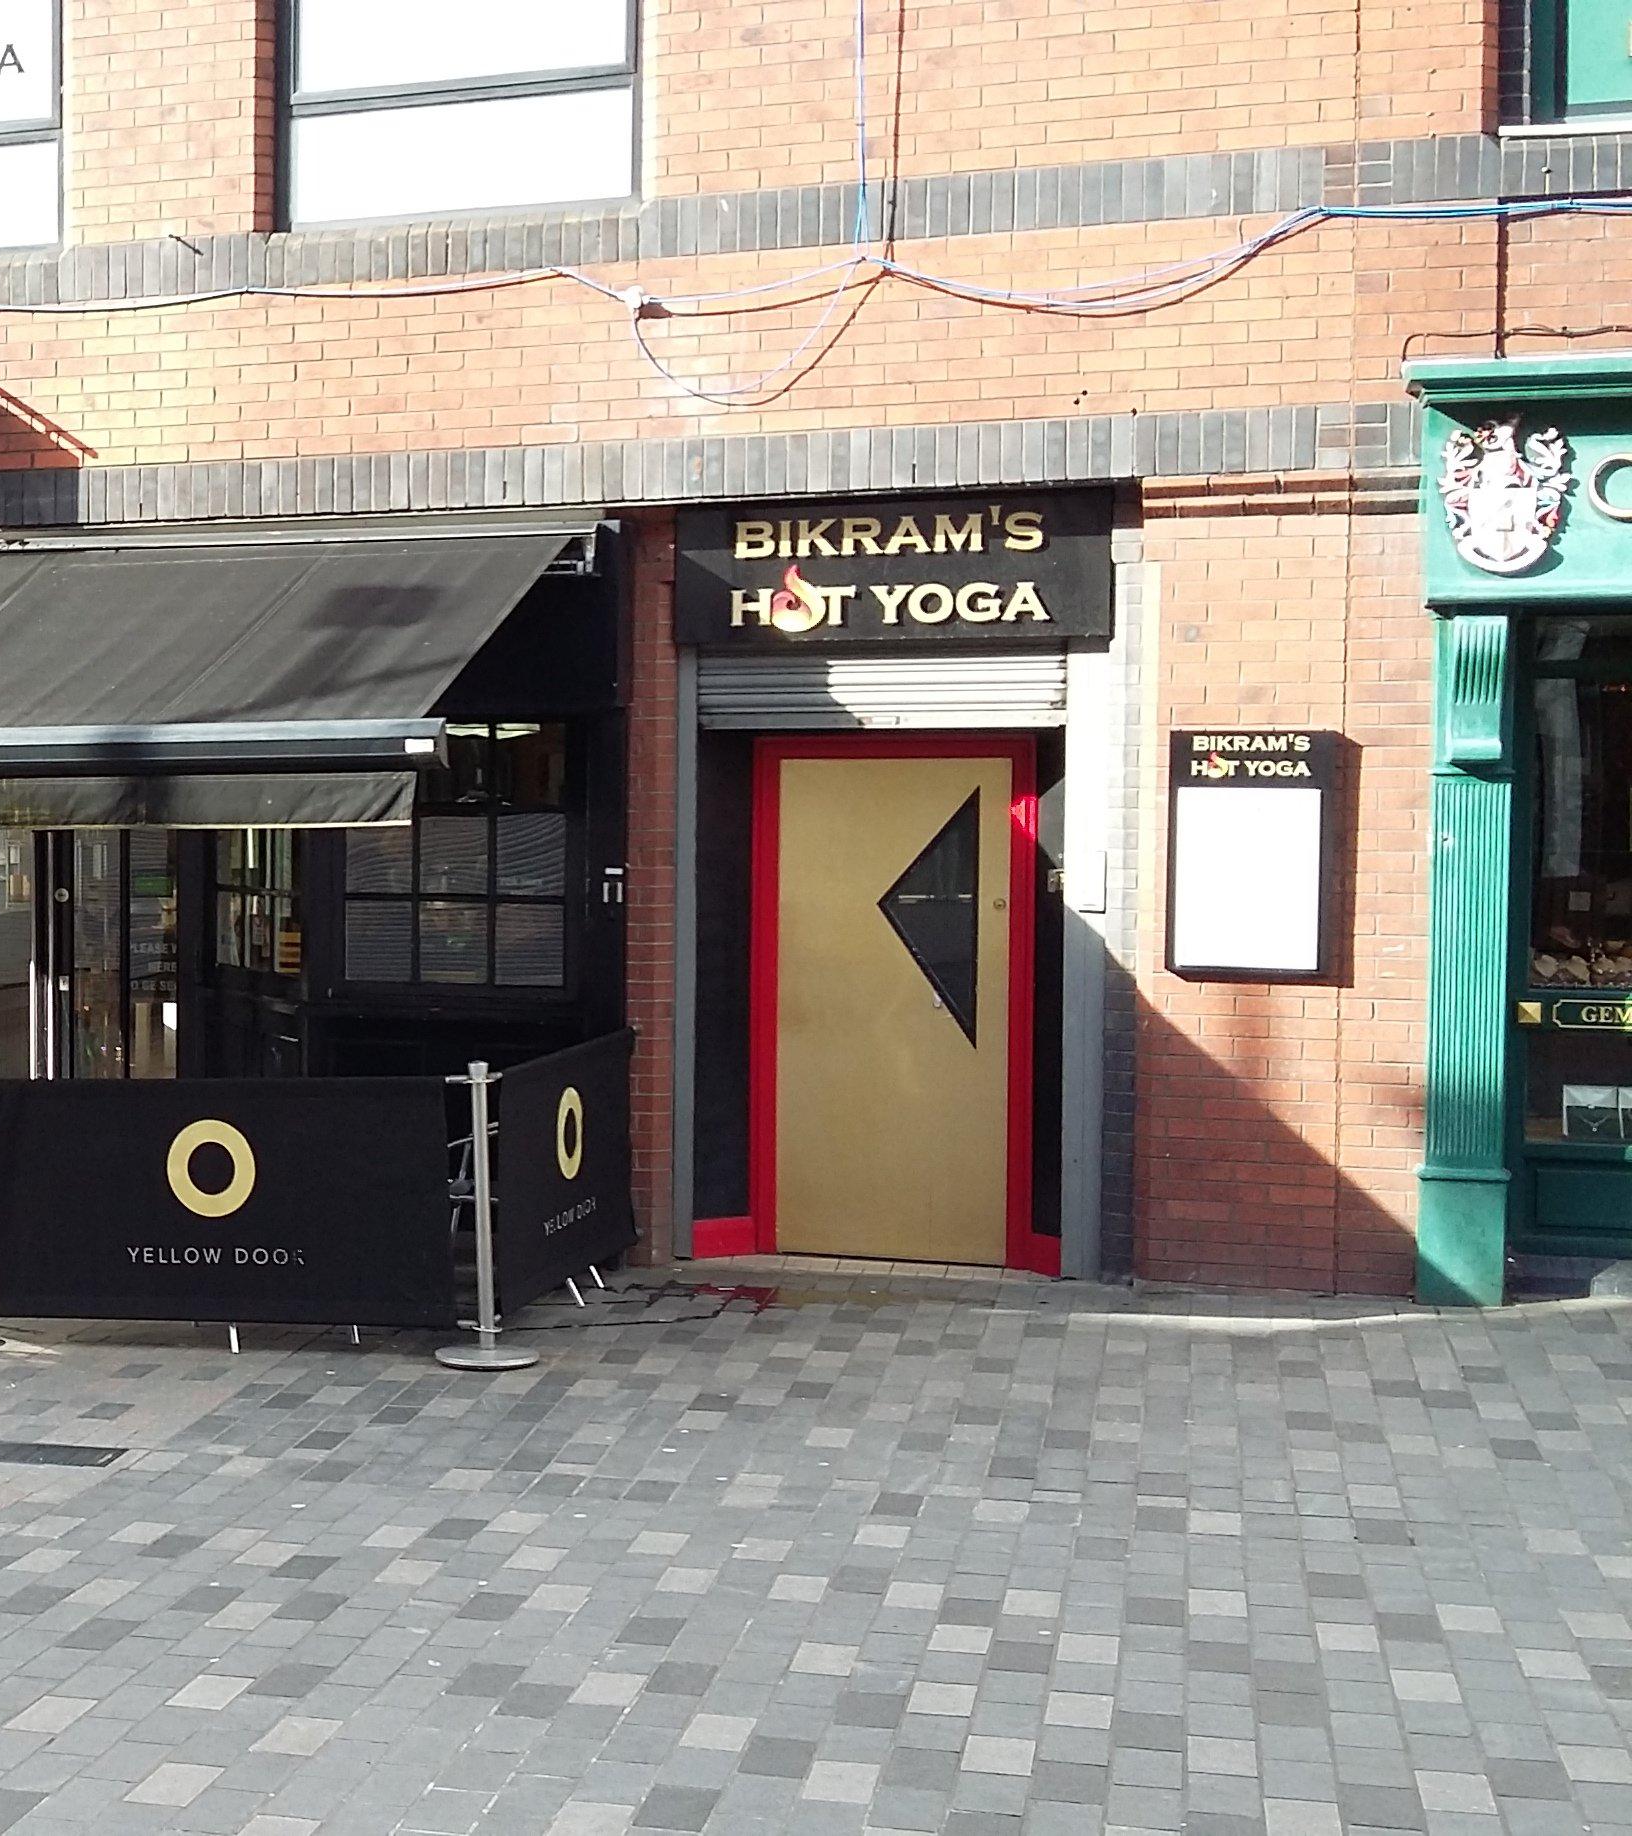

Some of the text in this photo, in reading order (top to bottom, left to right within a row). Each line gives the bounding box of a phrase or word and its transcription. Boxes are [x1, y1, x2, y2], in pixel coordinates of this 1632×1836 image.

[733, 505, 1044, 559] BIKRAM'S
[729, 563, 1051, 633] HOT YOGA
[1192, 733, 1311, 752] BIKRAM'S
[1190, 752, 1312, 779] HOT YOGA
[542, 1208, 574, 1237] YELOW
[126, 1247, 222, 1264] YELLOW
